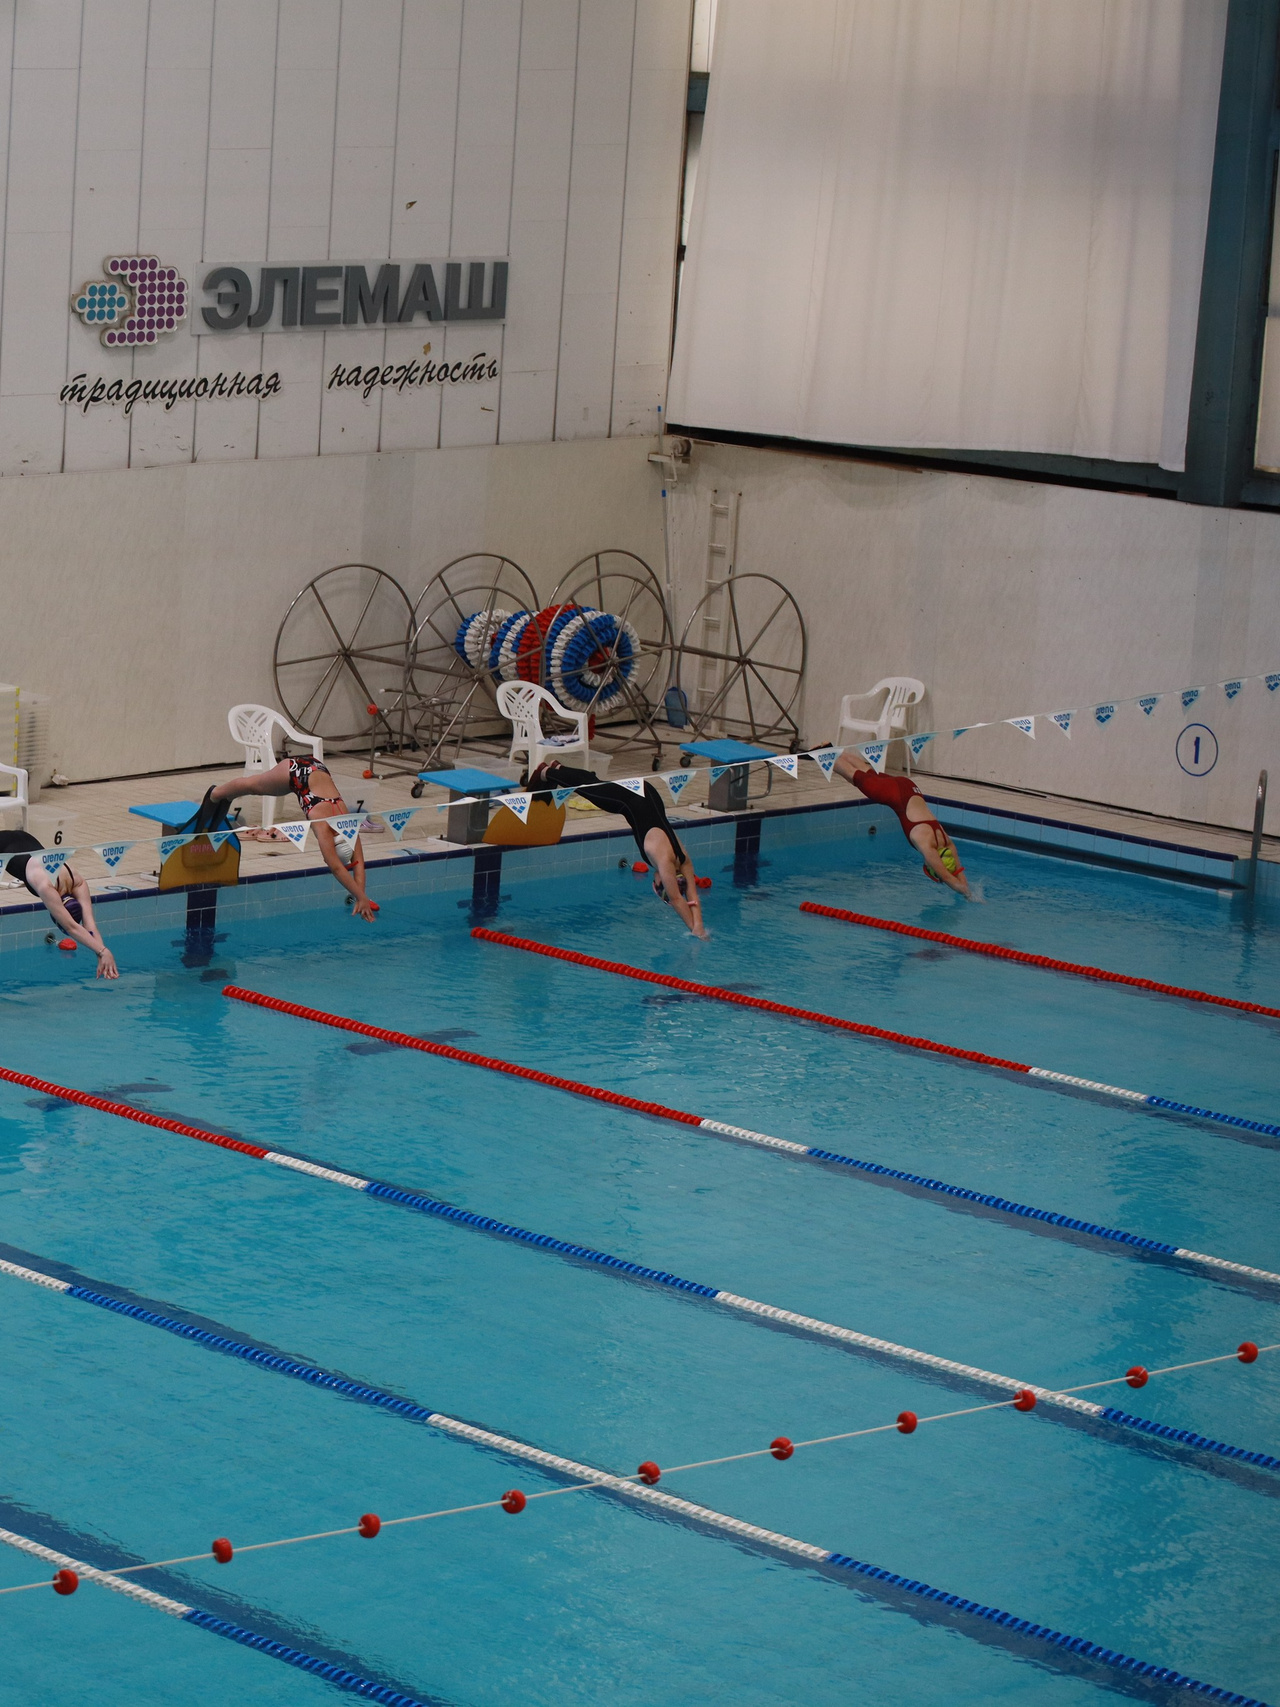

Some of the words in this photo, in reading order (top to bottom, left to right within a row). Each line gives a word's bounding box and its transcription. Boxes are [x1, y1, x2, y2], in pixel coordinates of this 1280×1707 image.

[201, 262, 509, 330] ЭЛЕМАШ
[60, 371, 282, 416] традиционная
[327, 352, 500, 397] надежность
[1193, 736, 1201, 764] 1
[356, 800, 365, 814] 7
[234, 807, 242, 822] 7
[389, 811, 411, 822] arena
[281, 824, 304, 834] arena
[336, 818, 358, 830] arena
[54, 830, 63, 846] 6
[42, 852, 65, 864] arena
[103, 846, 124, 858] arena
